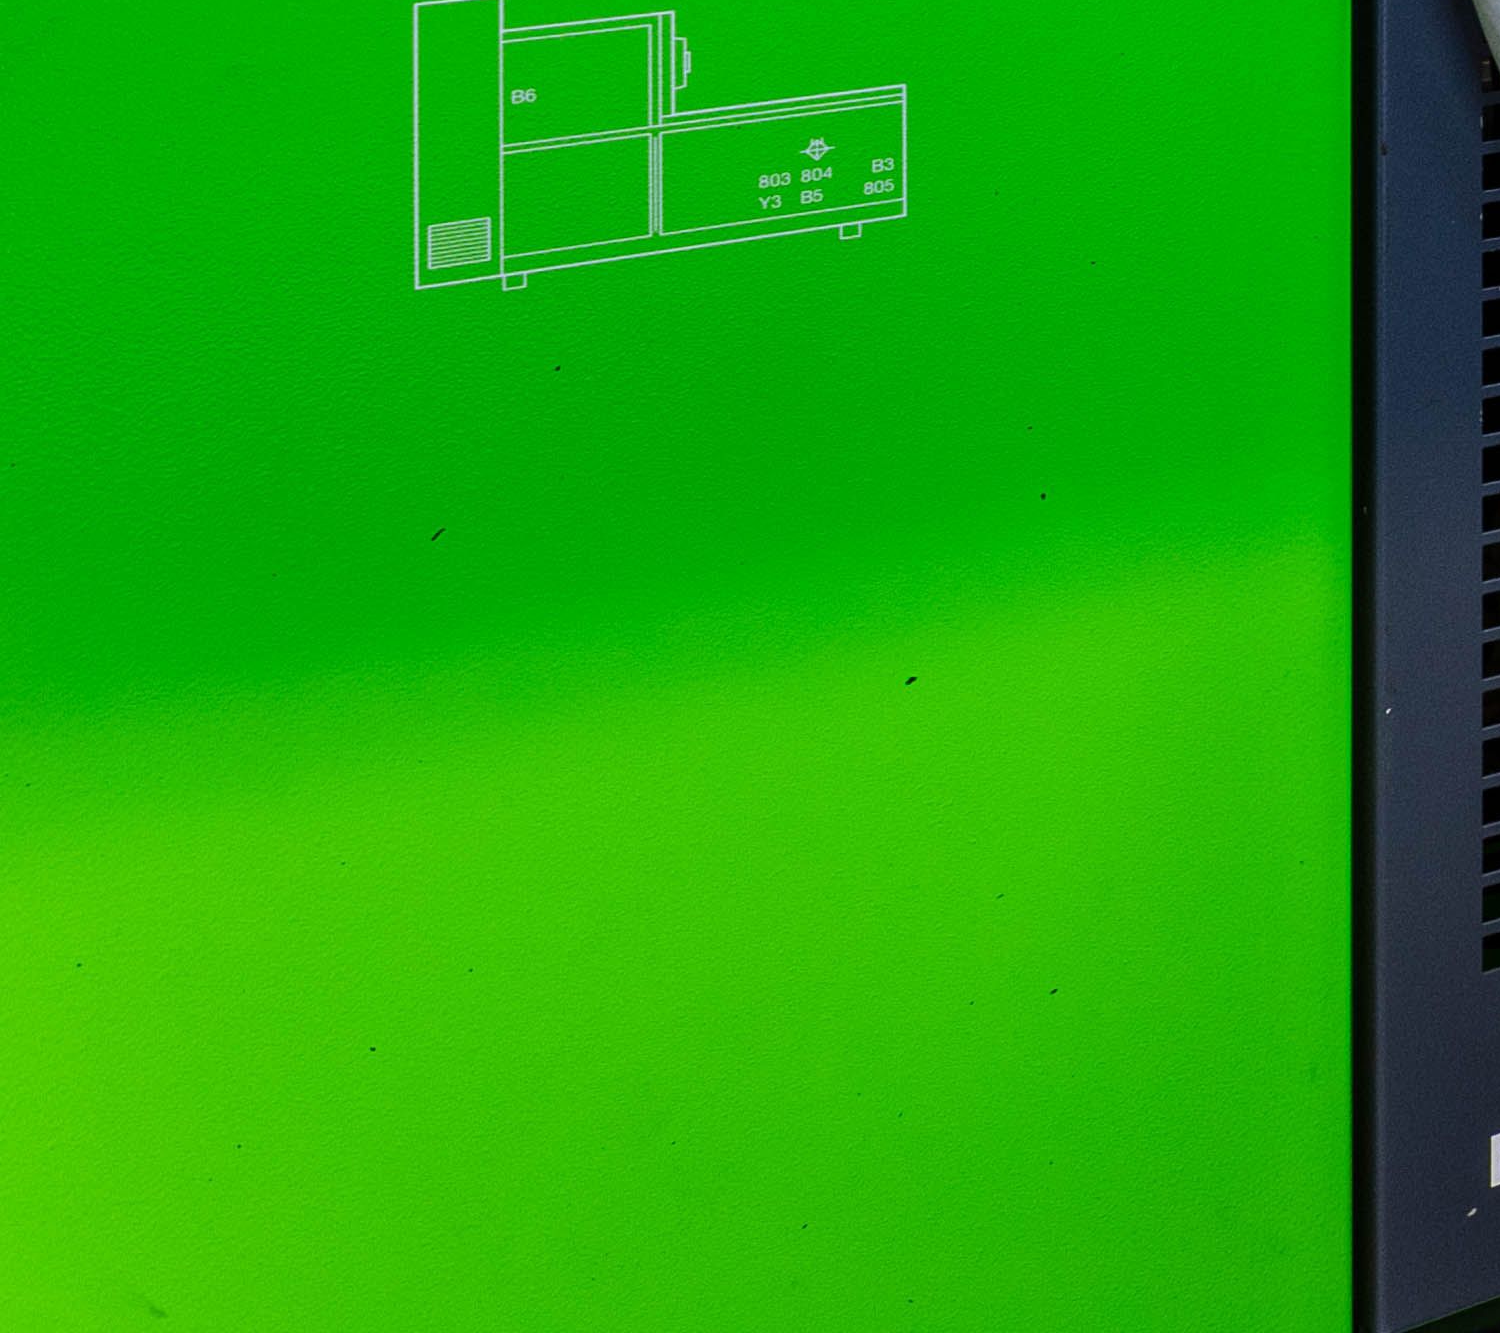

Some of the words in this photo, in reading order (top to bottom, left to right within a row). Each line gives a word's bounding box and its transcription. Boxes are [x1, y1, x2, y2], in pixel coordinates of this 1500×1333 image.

[510, 88, 537, 105] B6
[871, 157, 895, 174] B3
[758, 171, 792, 189] 803
[800, 166, 833, 184] 804
[863, 179, 895, 196] 805
[758, 194, 782, 210] Y3
[800, 188, 824, 205] B5
